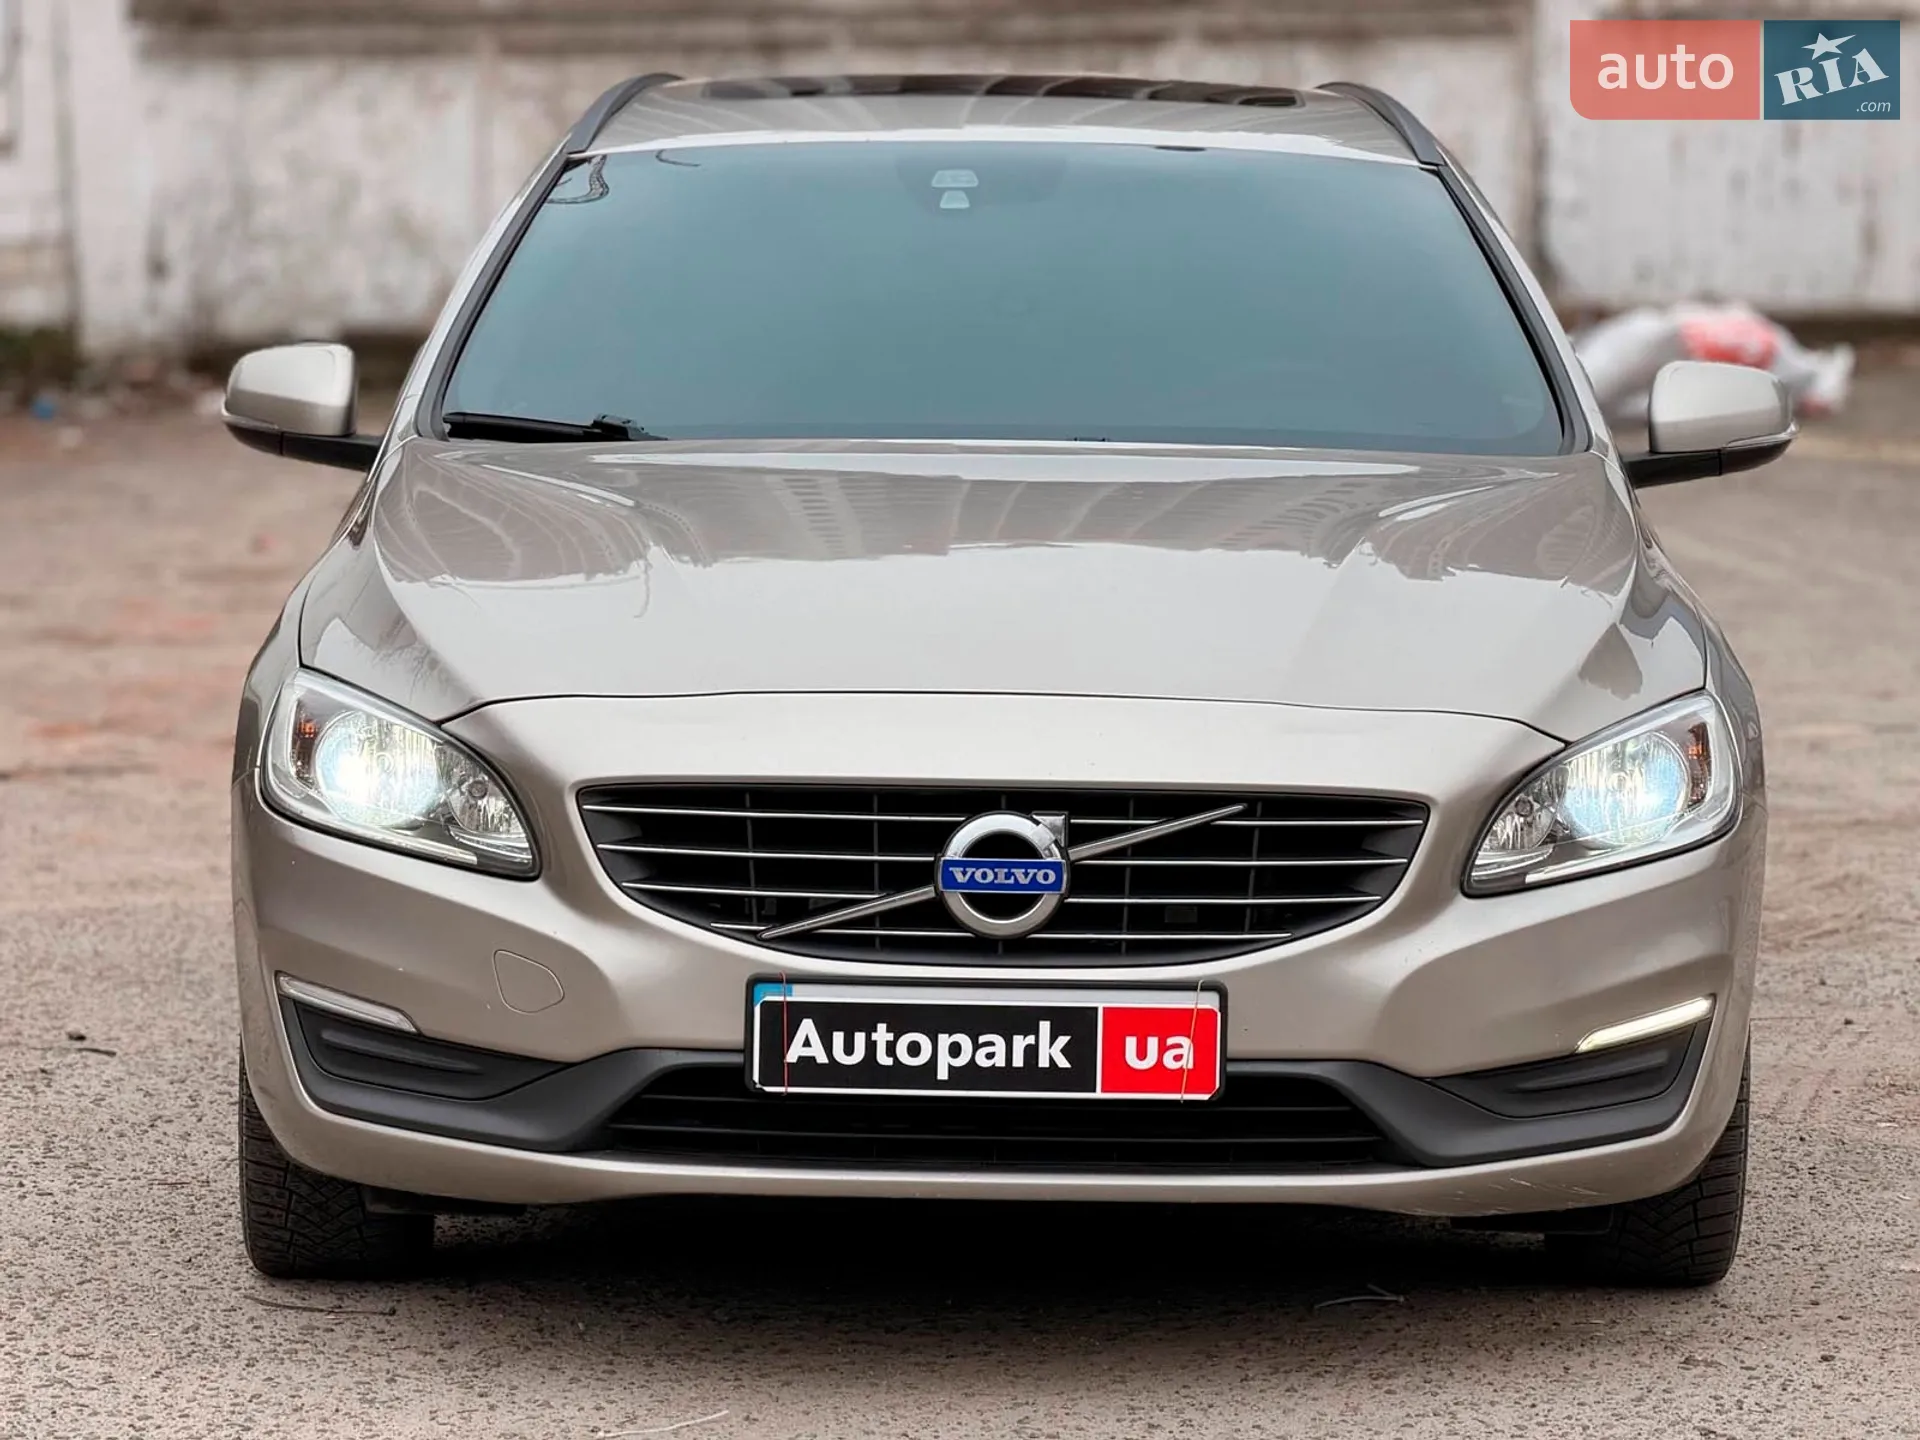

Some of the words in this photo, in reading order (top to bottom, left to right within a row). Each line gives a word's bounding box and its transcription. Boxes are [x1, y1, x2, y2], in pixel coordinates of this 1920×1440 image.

[948, 866, 1057, 885] VOLVO
[784, 1017, 1072, 1080] Autopark
[1124, 1034, 1195, 1070] ua
